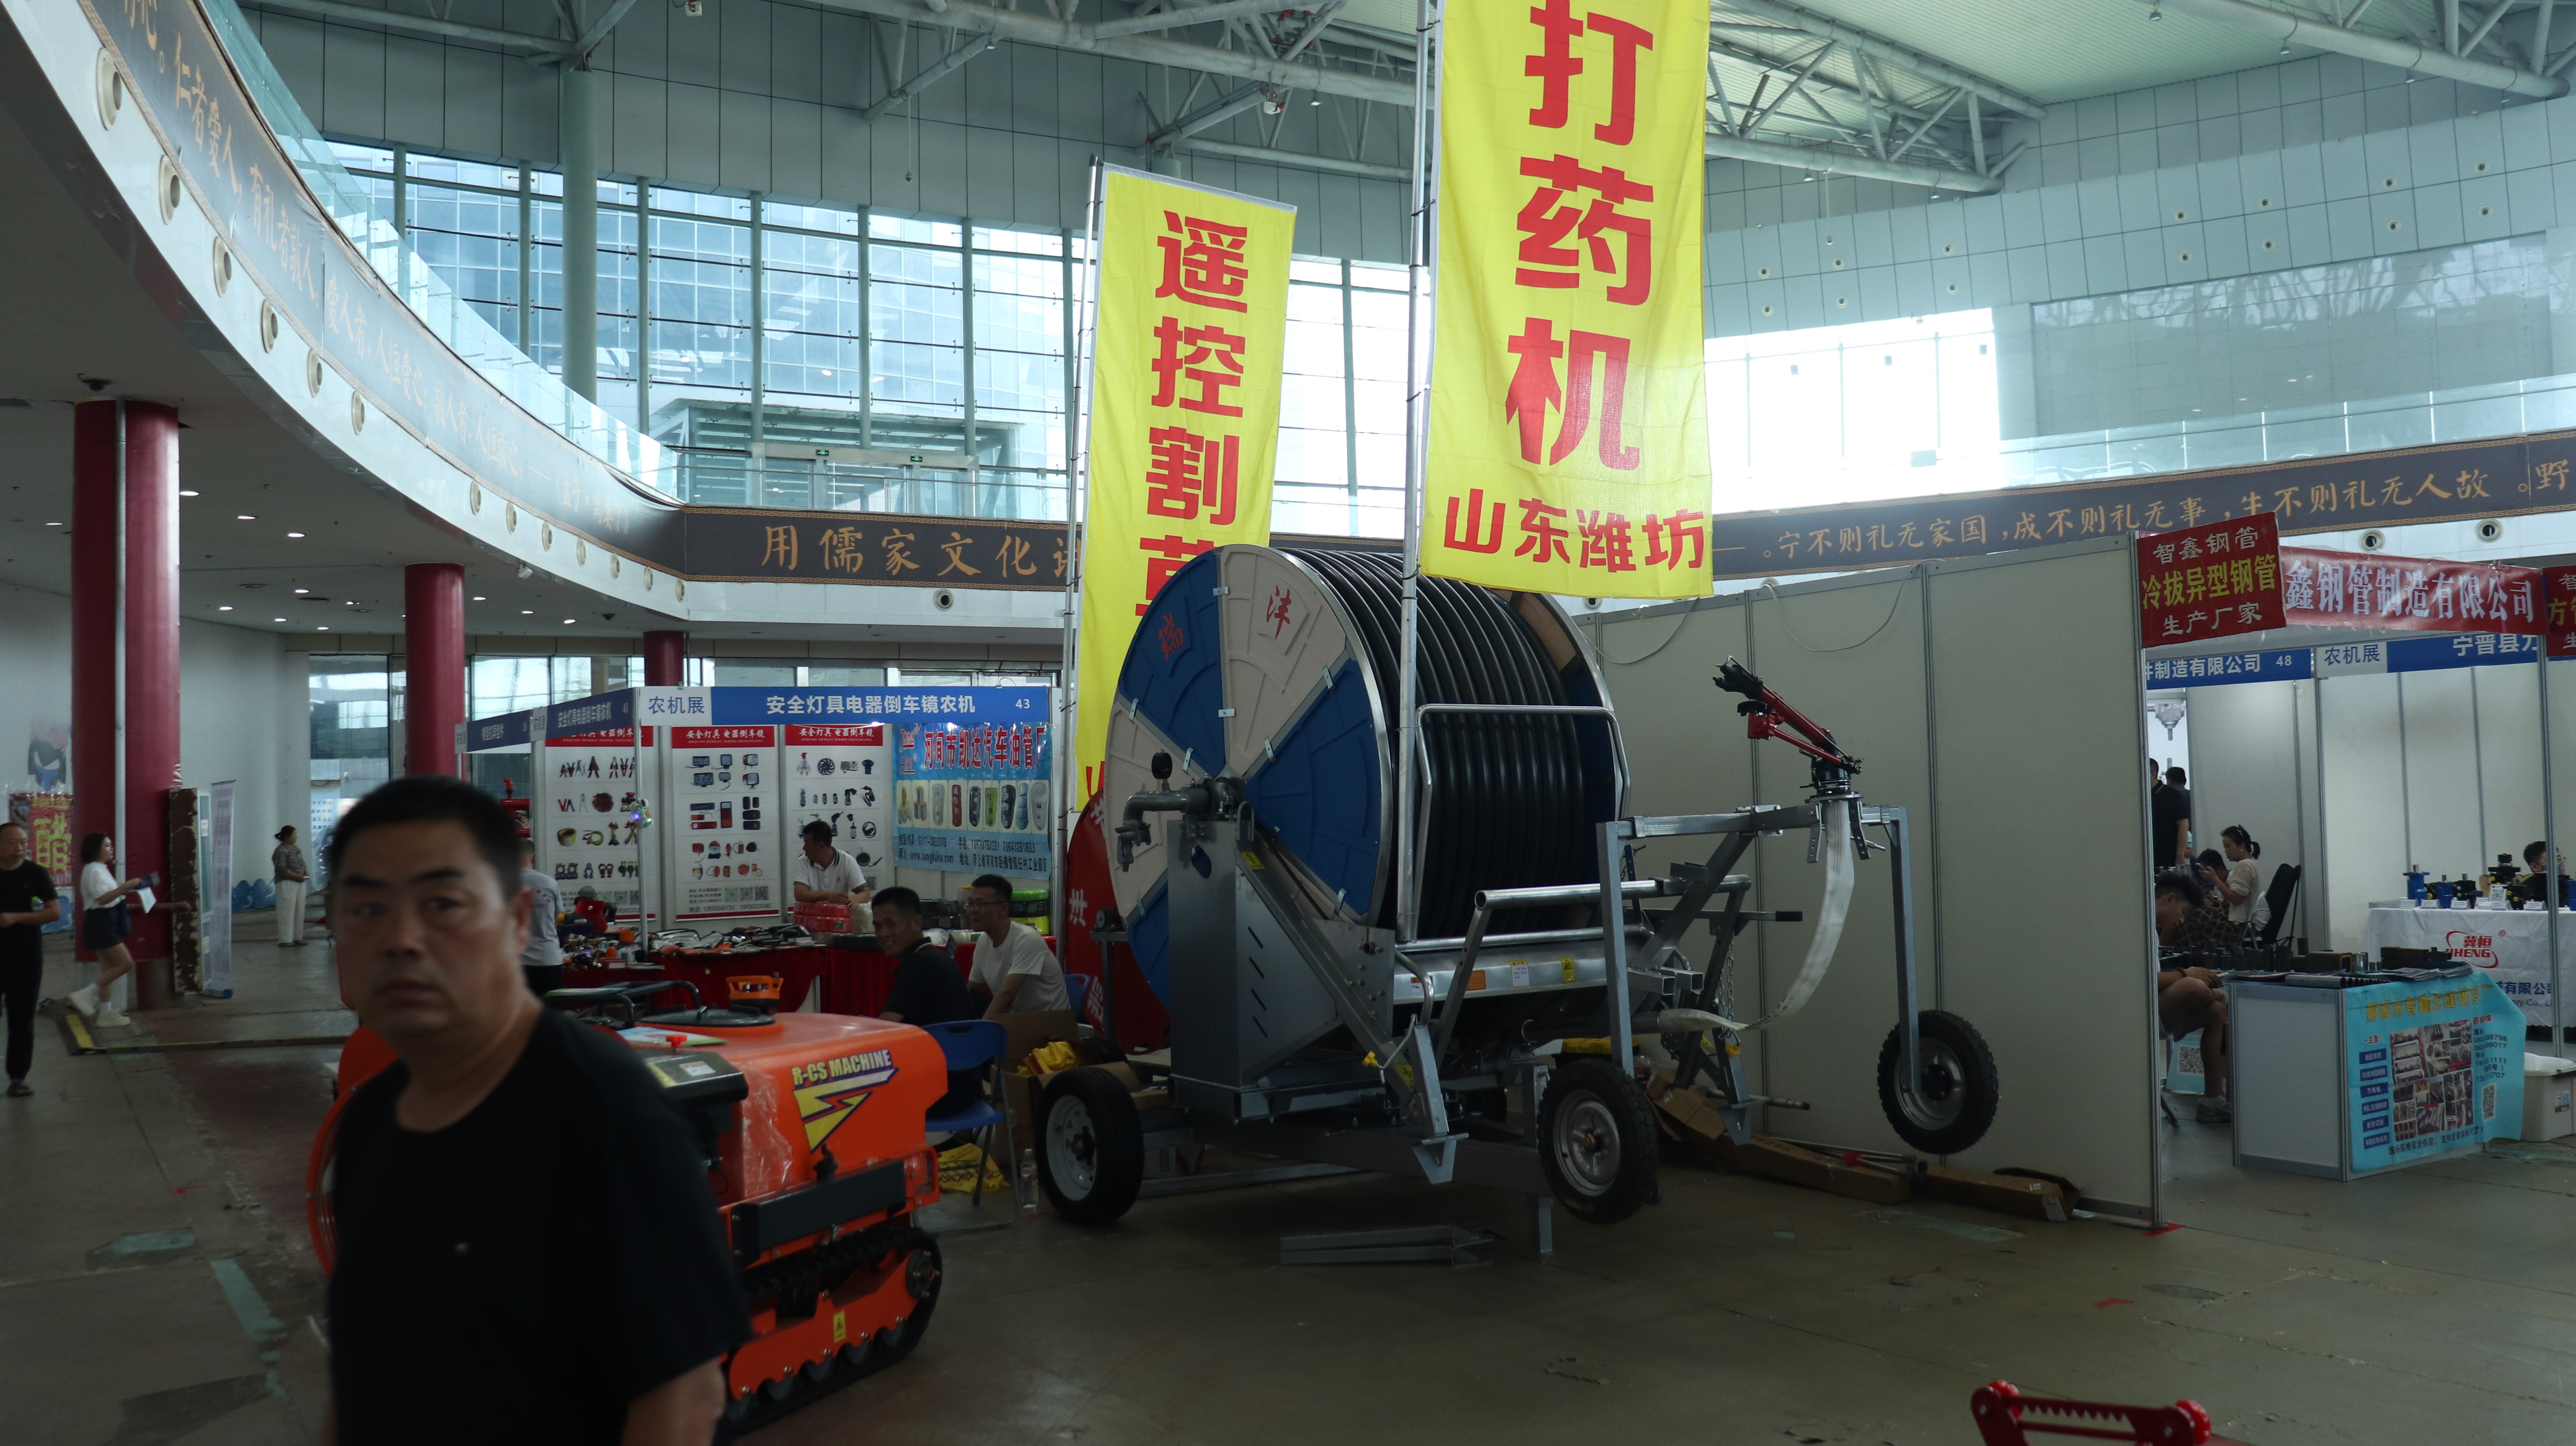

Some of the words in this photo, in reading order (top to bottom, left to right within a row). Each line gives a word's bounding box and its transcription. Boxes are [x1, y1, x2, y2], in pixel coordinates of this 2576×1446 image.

[1507, 0, 1653, 471] 打药机
[1443, 488, 1704, 574] 山东潍坊
[2152, 526, 2259, 565] 智鑫钢管
[2142, 553, 2277, 610] 冷拔异型钢管
[2286, 559, 2534, 623] 鑫钢管制造有限公司
[2162, 602, 2262, 637] 生产厂家
[2276, 655, 2292, 667] 48
[2324, 643, 2380, 666] 农机展
[648, 696, 705, 714] 农机展
[766, 695, 975, 715] 安全灯具电器倒车镜农机
[1015, 699, 1030, 710] 43
[686, 729, 721, 739] 安全灯具
[723, 729, 766, 739] 电器倒车镜
[799, 728, 832, 737] 安全灯具
[835, 728, 874, 737] 电器倒车镜
[924, 725, 1047, 769] 河间市凯达汽车油管厂
[792, 1061, 829, 1085] R-CS
[828, 1048, 892, 1078] MACHINE
